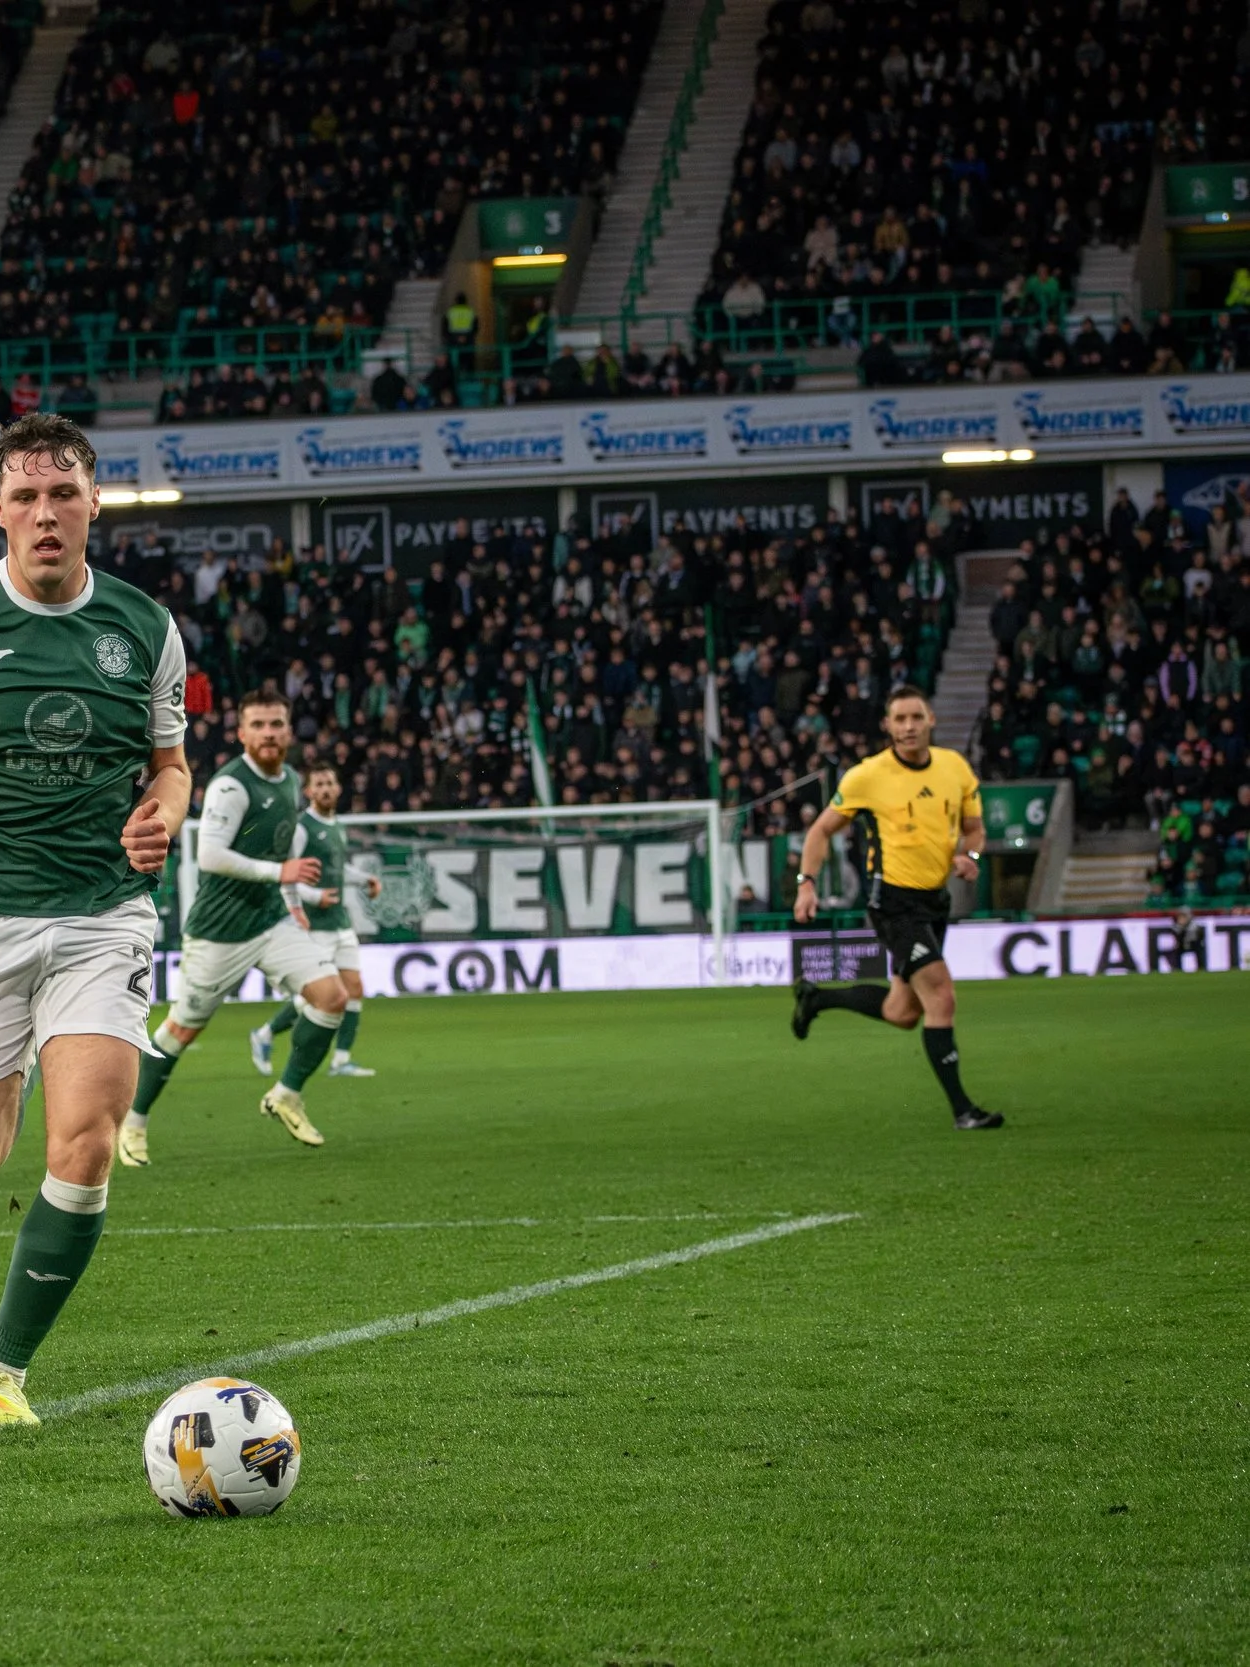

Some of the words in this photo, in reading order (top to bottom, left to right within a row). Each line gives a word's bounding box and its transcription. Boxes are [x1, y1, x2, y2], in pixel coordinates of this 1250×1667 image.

[1025, 797, 1047, 825] 6
[421, 842, 770, 934] SEVEN
[393, 946, 561, 995] COM
